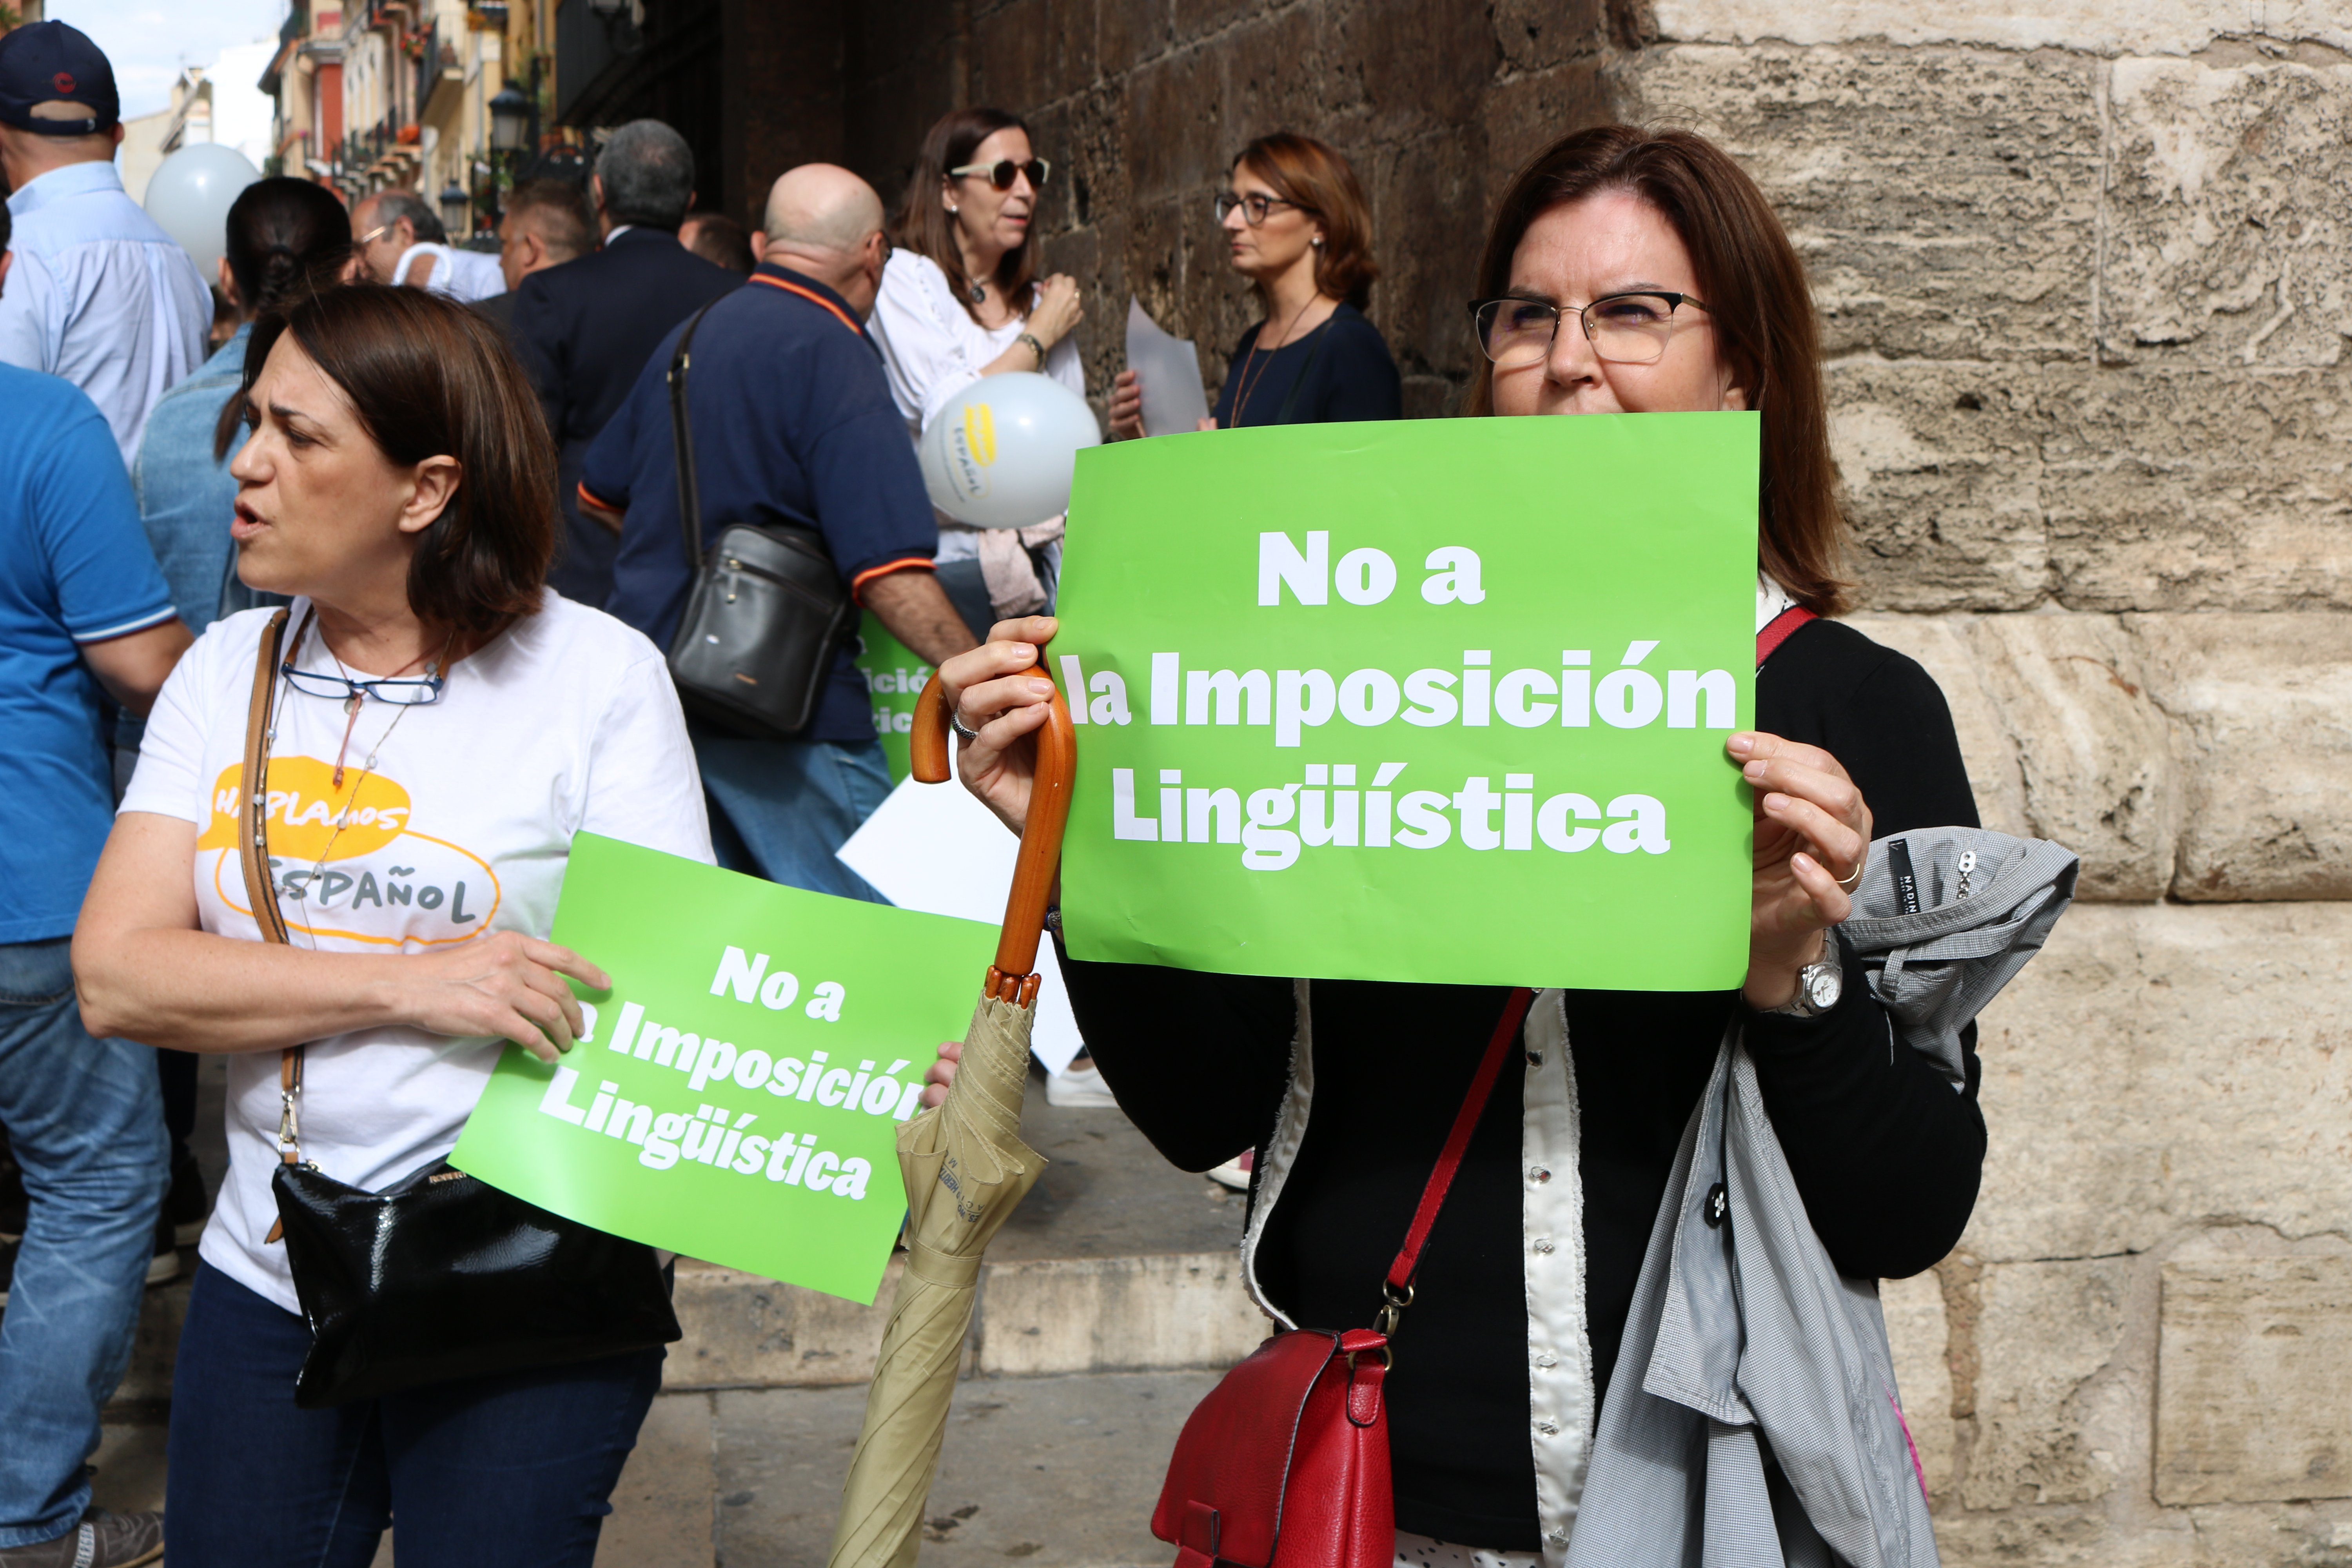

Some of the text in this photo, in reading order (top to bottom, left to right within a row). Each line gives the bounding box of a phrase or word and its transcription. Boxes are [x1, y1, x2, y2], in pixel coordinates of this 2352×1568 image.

[1258, 530, 1486, 606] No a
[1059, 640, 1736, 747] la Imposición
[216, 786, 409, 829] HBLAMOS
[1112, 762, 1671, 871] Lingüística
[269, 859, 475, 924] SPAÑOL
[709, 945, 845, 1022] No a
[539, 1065, 872, 1200] Lingüística
